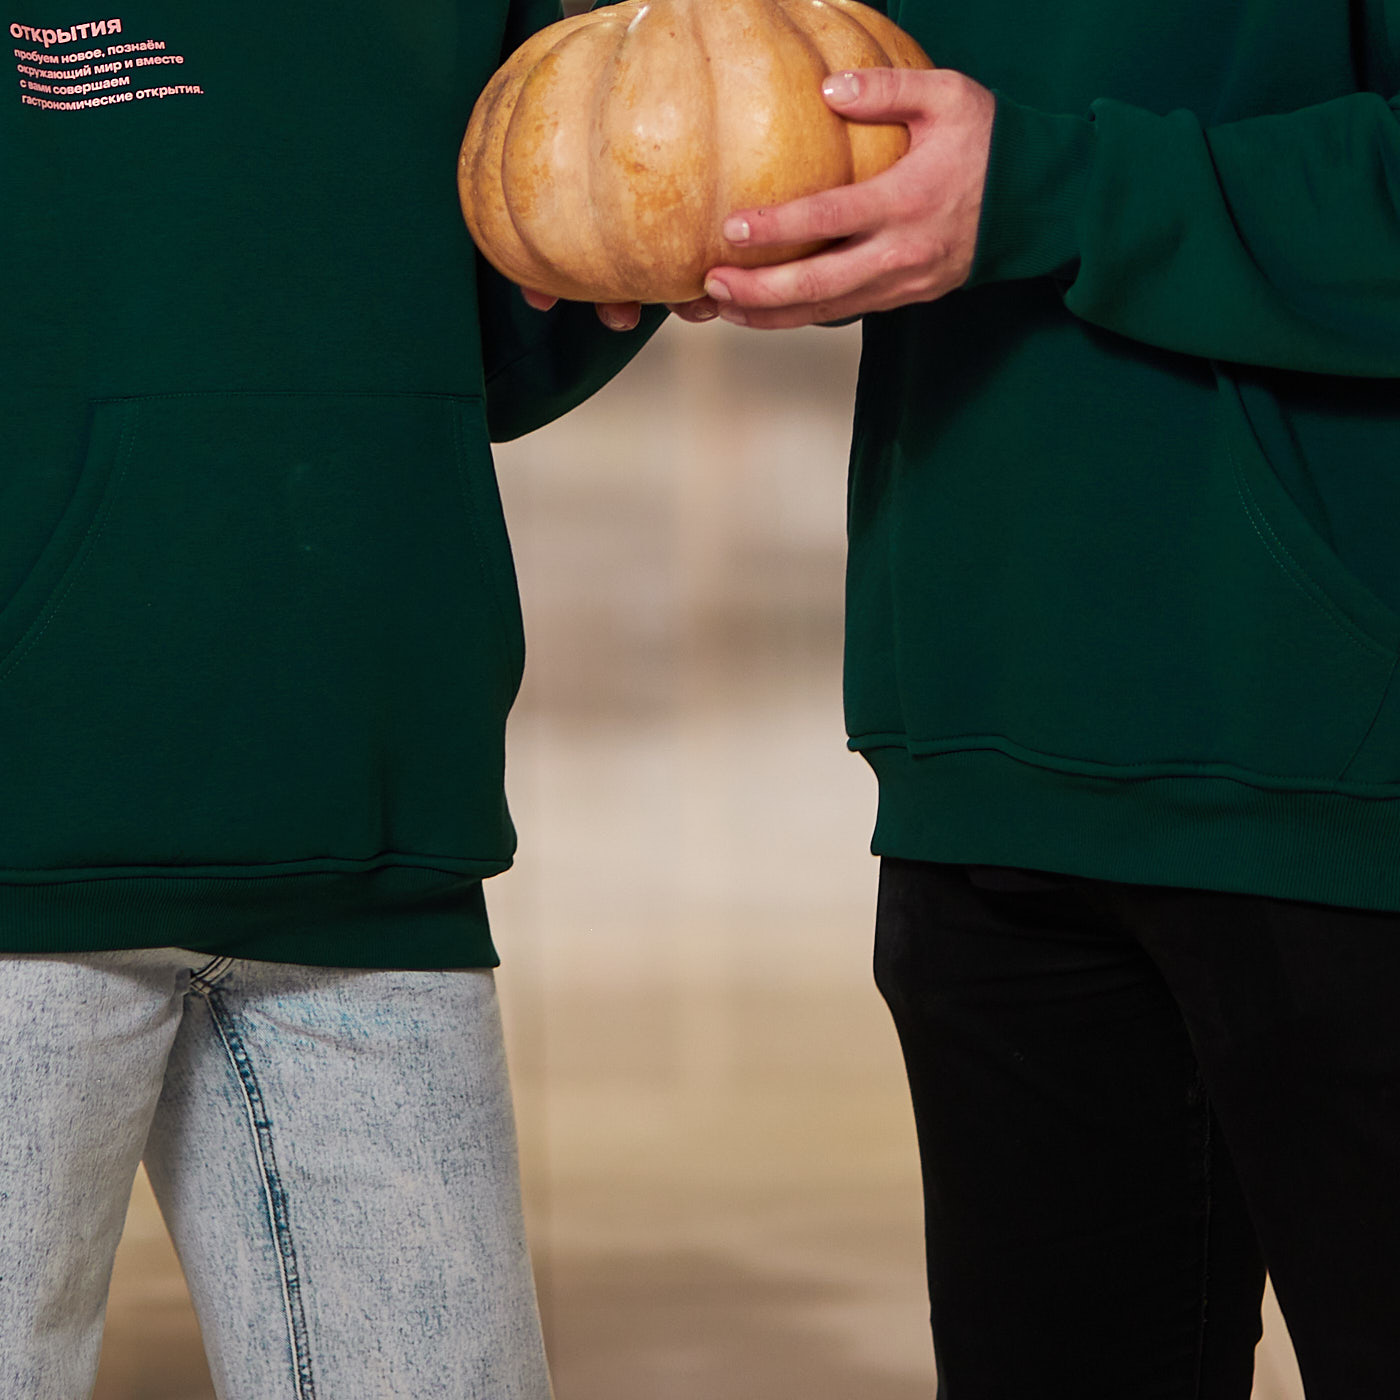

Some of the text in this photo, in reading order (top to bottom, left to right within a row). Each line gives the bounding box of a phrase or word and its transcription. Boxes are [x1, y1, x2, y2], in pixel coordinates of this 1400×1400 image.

[9, 18, 122, 48] открытия
[13, 39, 166, 64] пробуем новое, познаём
[17, 54, 184, 80] окружающий мир и вместе
[19, 75, 130, 96] с вами совершаем
[21, 84, 204, 111] гастрономические открытия.
